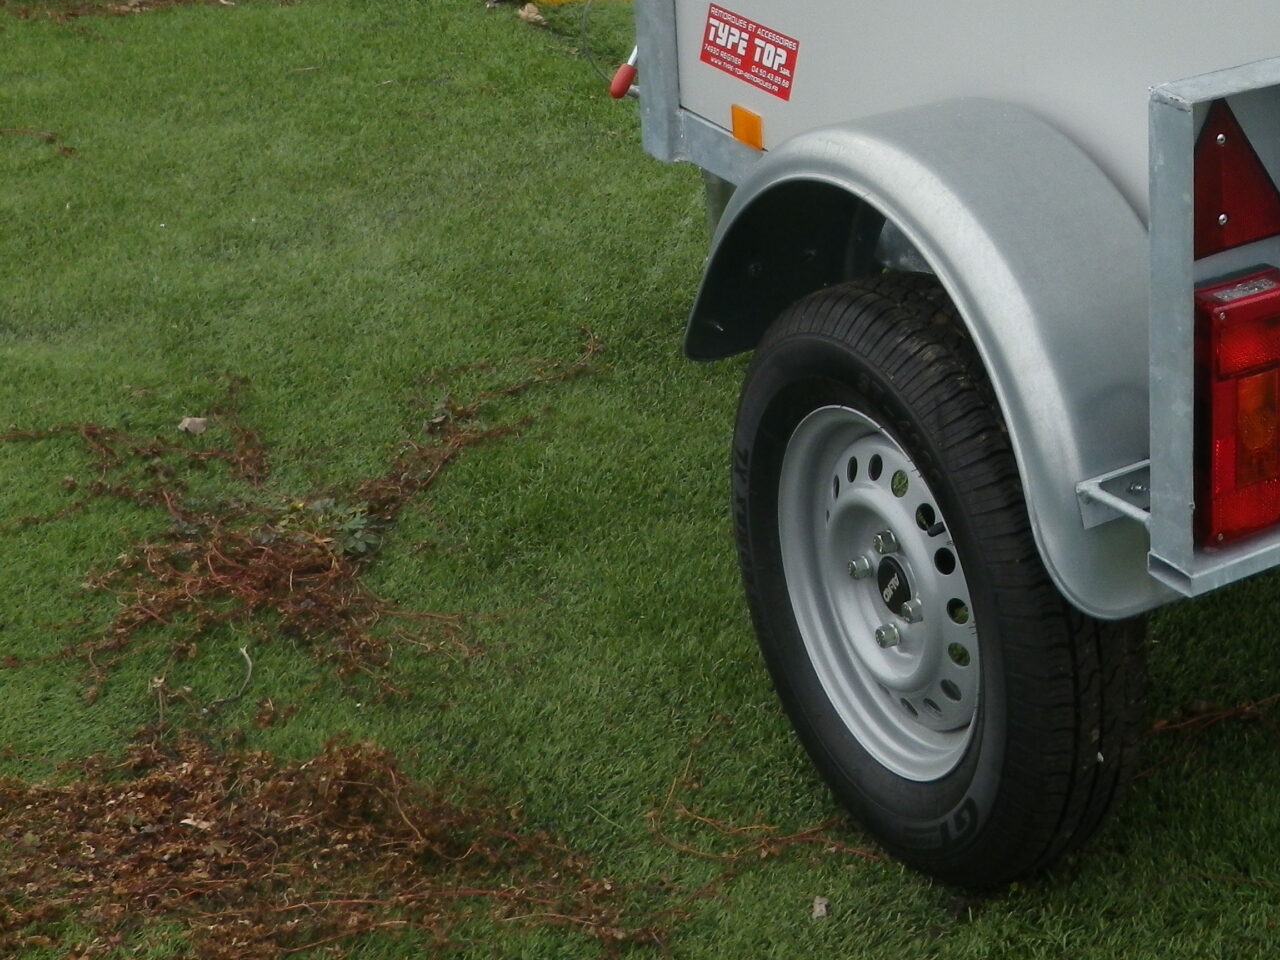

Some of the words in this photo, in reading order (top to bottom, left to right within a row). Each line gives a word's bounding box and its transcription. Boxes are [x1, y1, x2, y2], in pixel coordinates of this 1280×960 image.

[748, 23, 756, 33] ET
[708, 18, 750, 56] TYPE
[754, 38, 788, 71] TOP
